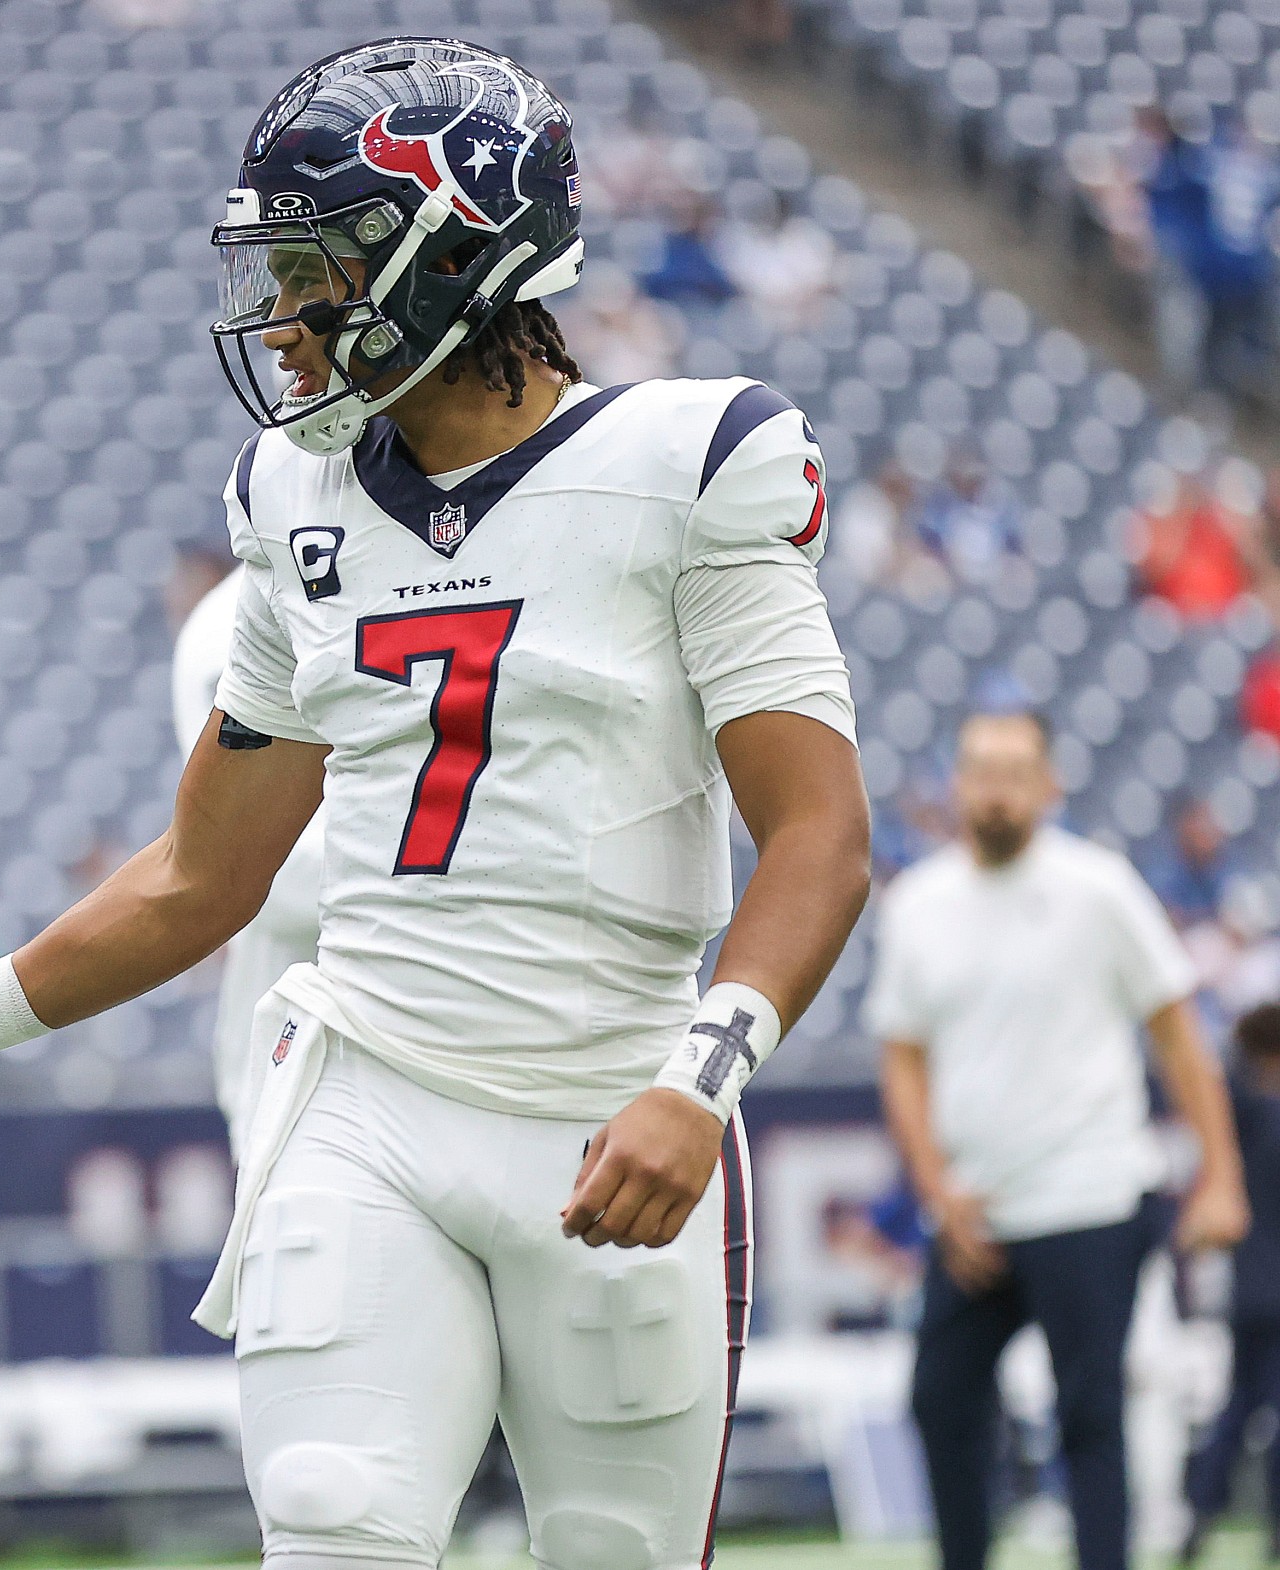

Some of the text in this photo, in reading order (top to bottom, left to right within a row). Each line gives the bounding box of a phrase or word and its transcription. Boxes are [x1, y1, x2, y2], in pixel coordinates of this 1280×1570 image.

[267, 208, 312, 219] OAKLEY
[435, 522, 460, 541] NFL
[292, 530, 337, 581] C
[392, 576, 492, 599] TEXANS
[355, 599, 524, 876] 7
